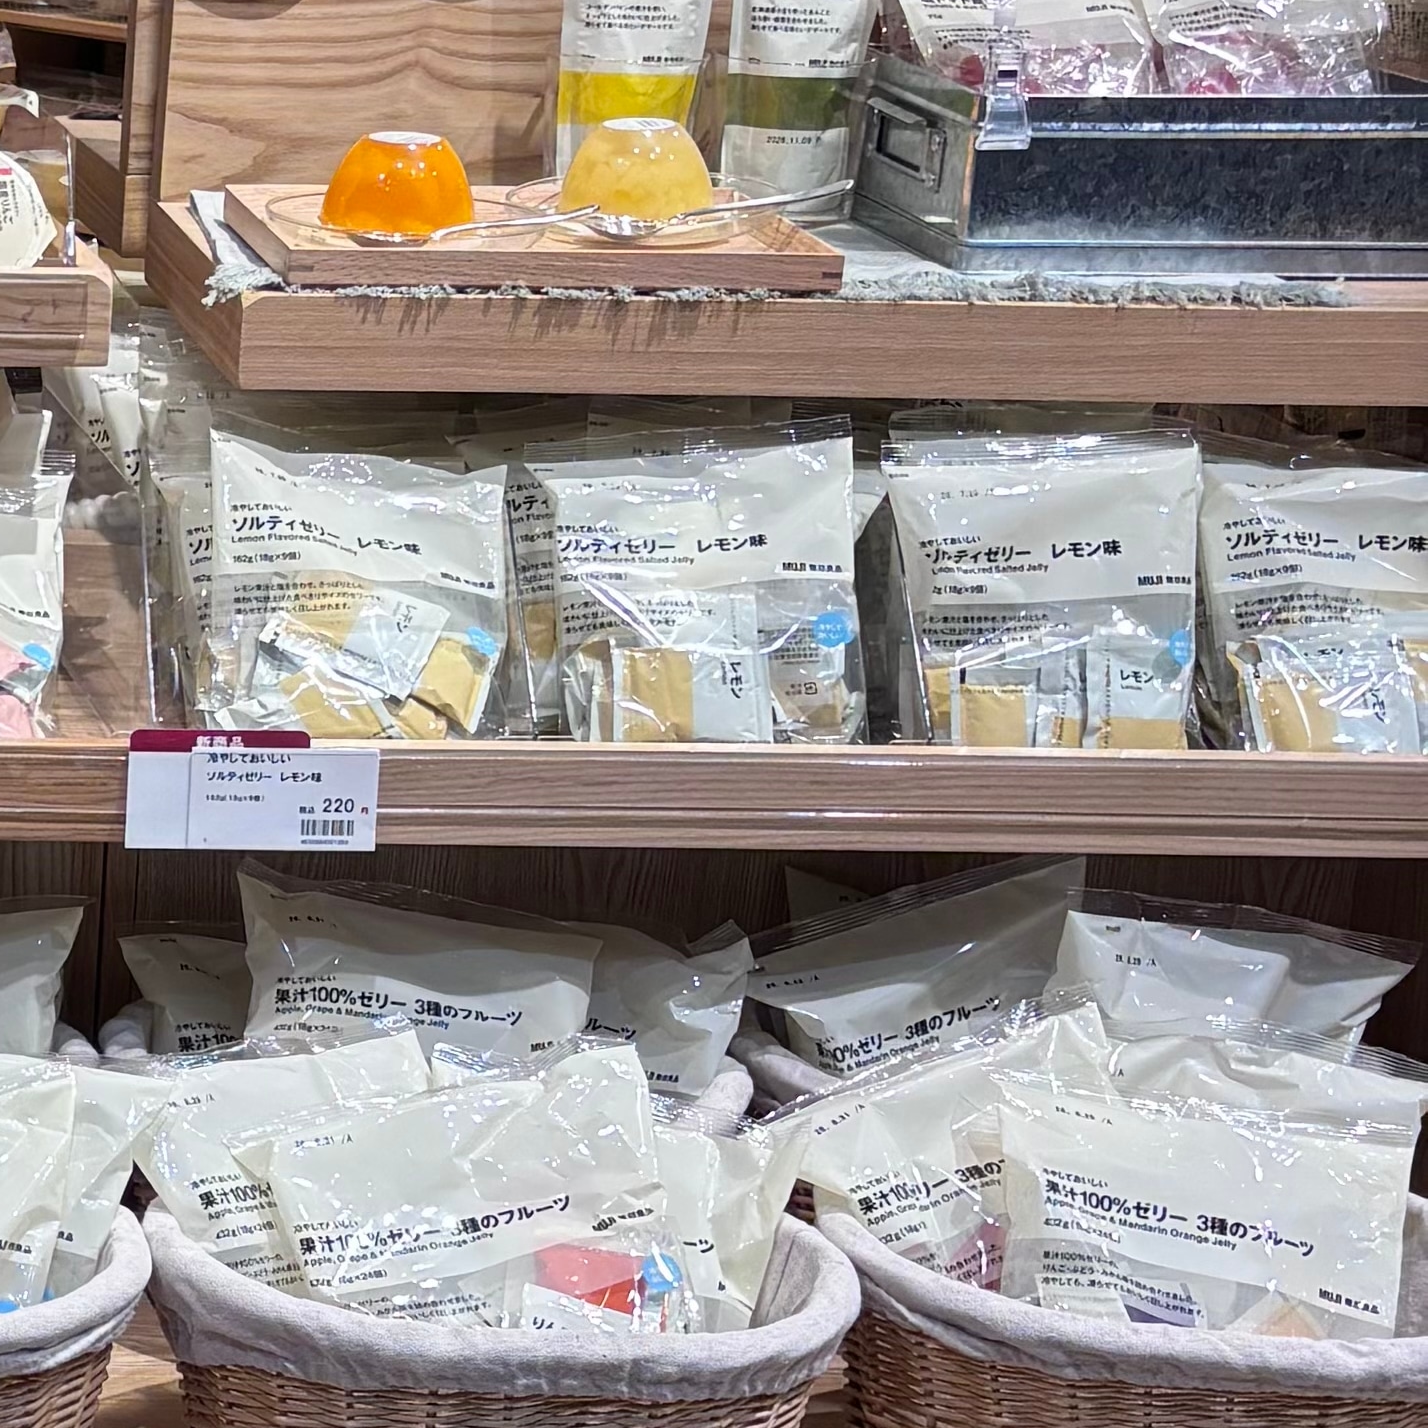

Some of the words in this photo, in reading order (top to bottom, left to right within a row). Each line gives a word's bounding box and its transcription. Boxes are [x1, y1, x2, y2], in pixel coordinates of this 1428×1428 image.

[231, 535, 265, 543] Lemon
[232, 516, 340, 540] ソルティゼリー
[358, 537, 422, 555] レモン味
[697, 534, 769, 553] レモン味
[1226, 530, 1339, 550] ソルティゼリー
[1359, 535, 1428, 553] レモン味
[1051, 539, 1122, 559] レモン味
[1227, 549, 1263, 561] Lemon
[1137, 575, 1163, 586] MUJI
[729, 661, 744, 699] レモン
[1120, 669, 1153, 684] レモン
[206, 753, 292, 764] 冷やしておいしい
[206, 772, 273, 782] ソルティゼリー
[280, 772, 322, 783] レモン味
[322, 798, 354, 814] 220
[274, 986, 407, 1011] 果汁100%ゼリー
[413, 997, 523, 1026] 3種のフルーツ
[905, 996, 1001, 1040] 3種のフルーツ
[1044, 1179, 1188, 1225] 果汁100%ゼリー
